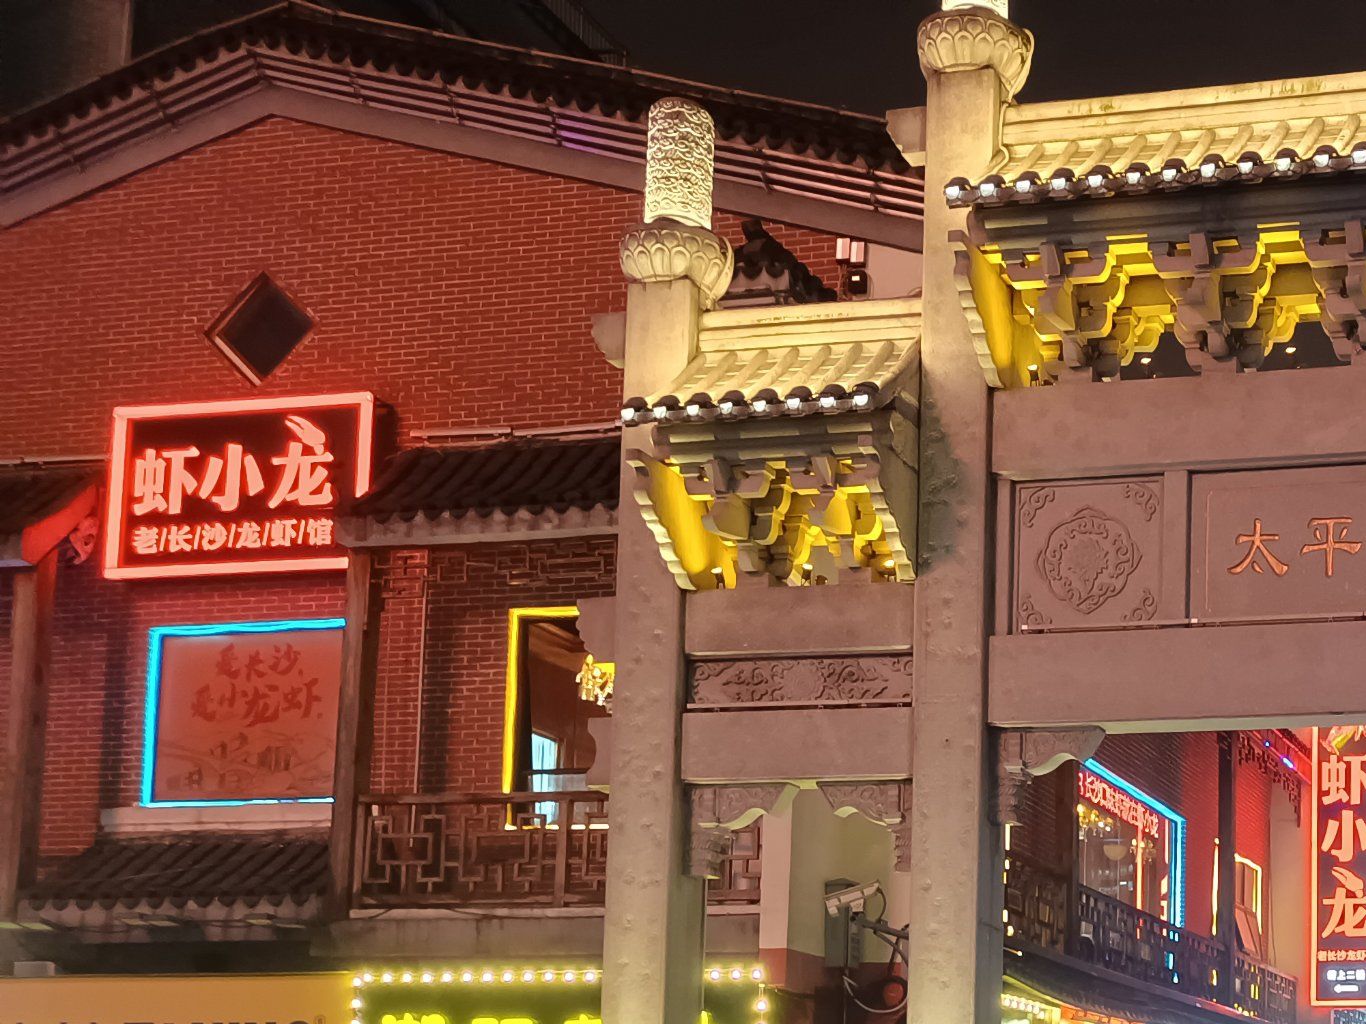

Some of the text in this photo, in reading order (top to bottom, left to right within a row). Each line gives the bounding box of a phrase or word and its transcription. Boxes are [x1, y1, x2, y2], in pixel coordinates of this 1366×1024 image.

[133, 441, 334, 516] 虾小龙
[132, 517, 335, 555] 老/长/沙/龙/虾/馆
